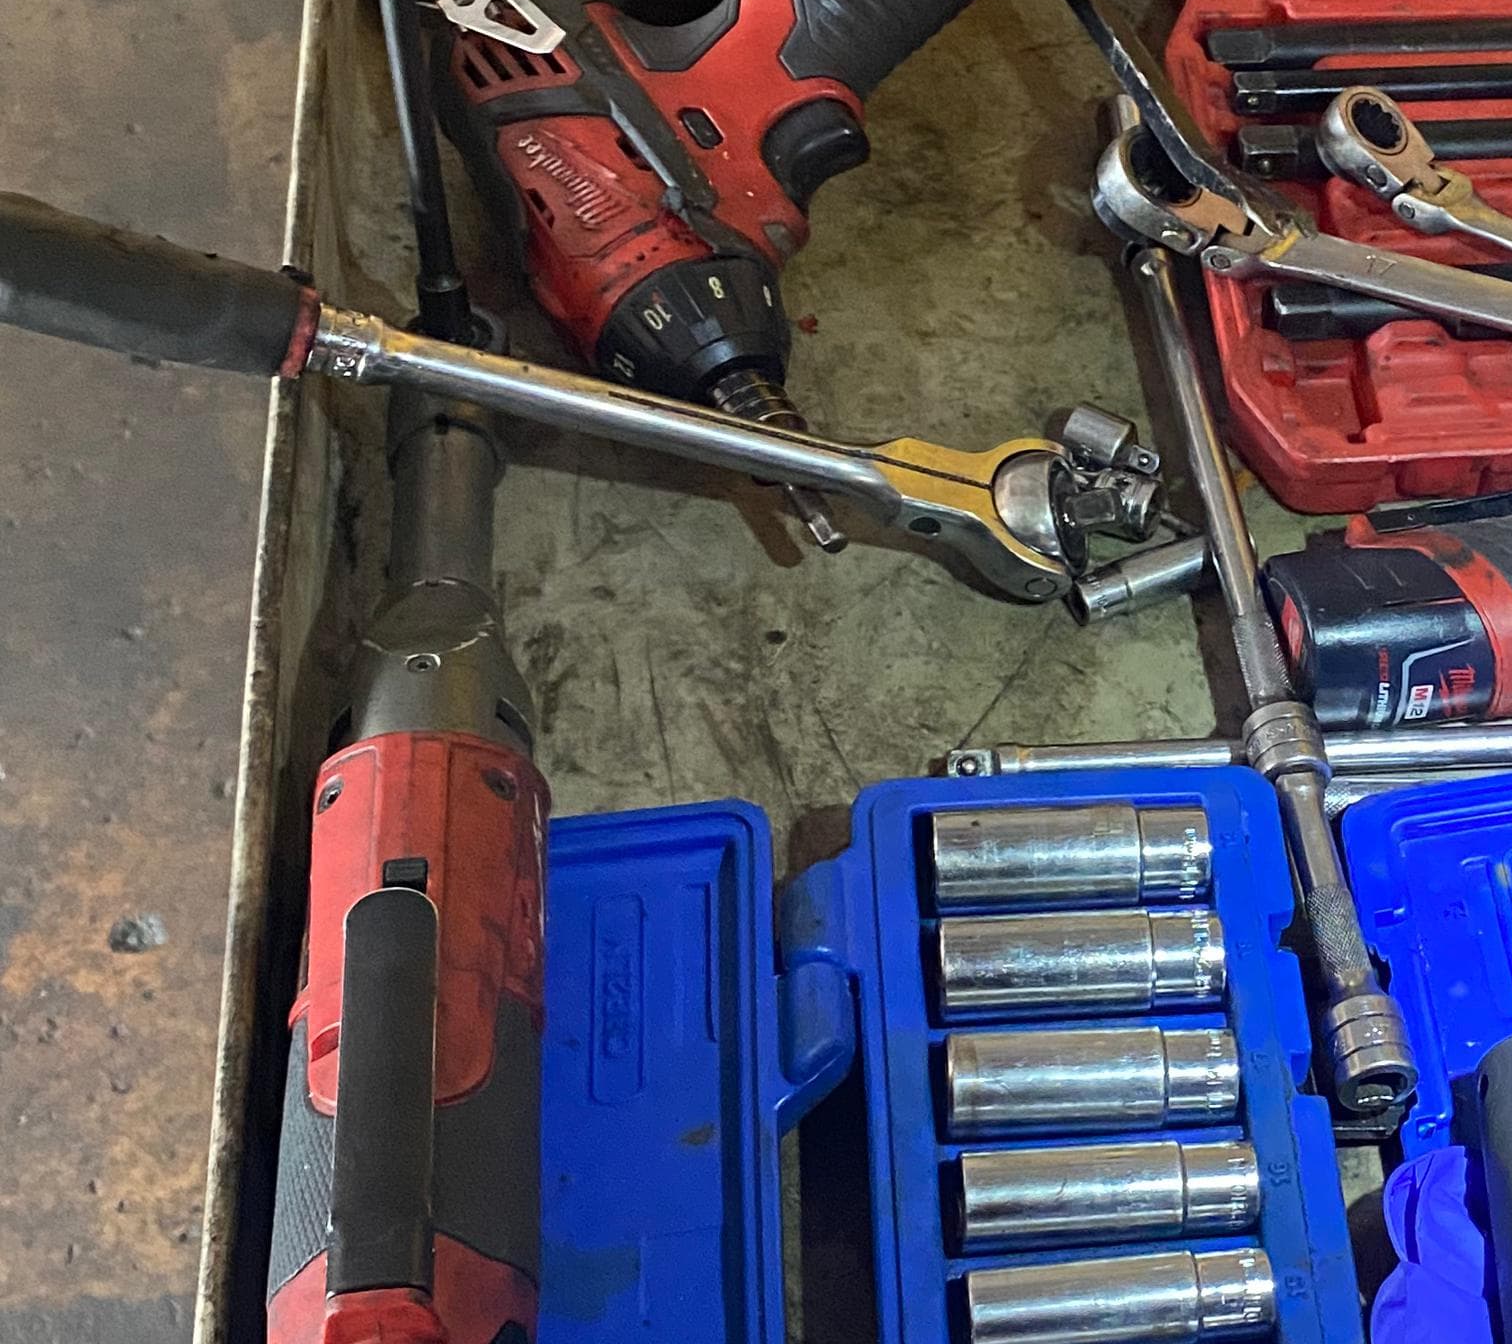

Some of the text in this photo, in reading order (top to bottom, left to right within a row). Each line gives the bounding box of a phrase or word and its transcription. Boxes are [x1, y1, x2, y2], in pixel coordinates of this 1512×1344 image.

[517, 133, 630, 230] Milwaukee
[707, 276, 726, 300] 8
[642, 302, 673, 331] 10
[1409, 686, 1430, 717] M12
[1267, 1160, 1292, 1188] 16
